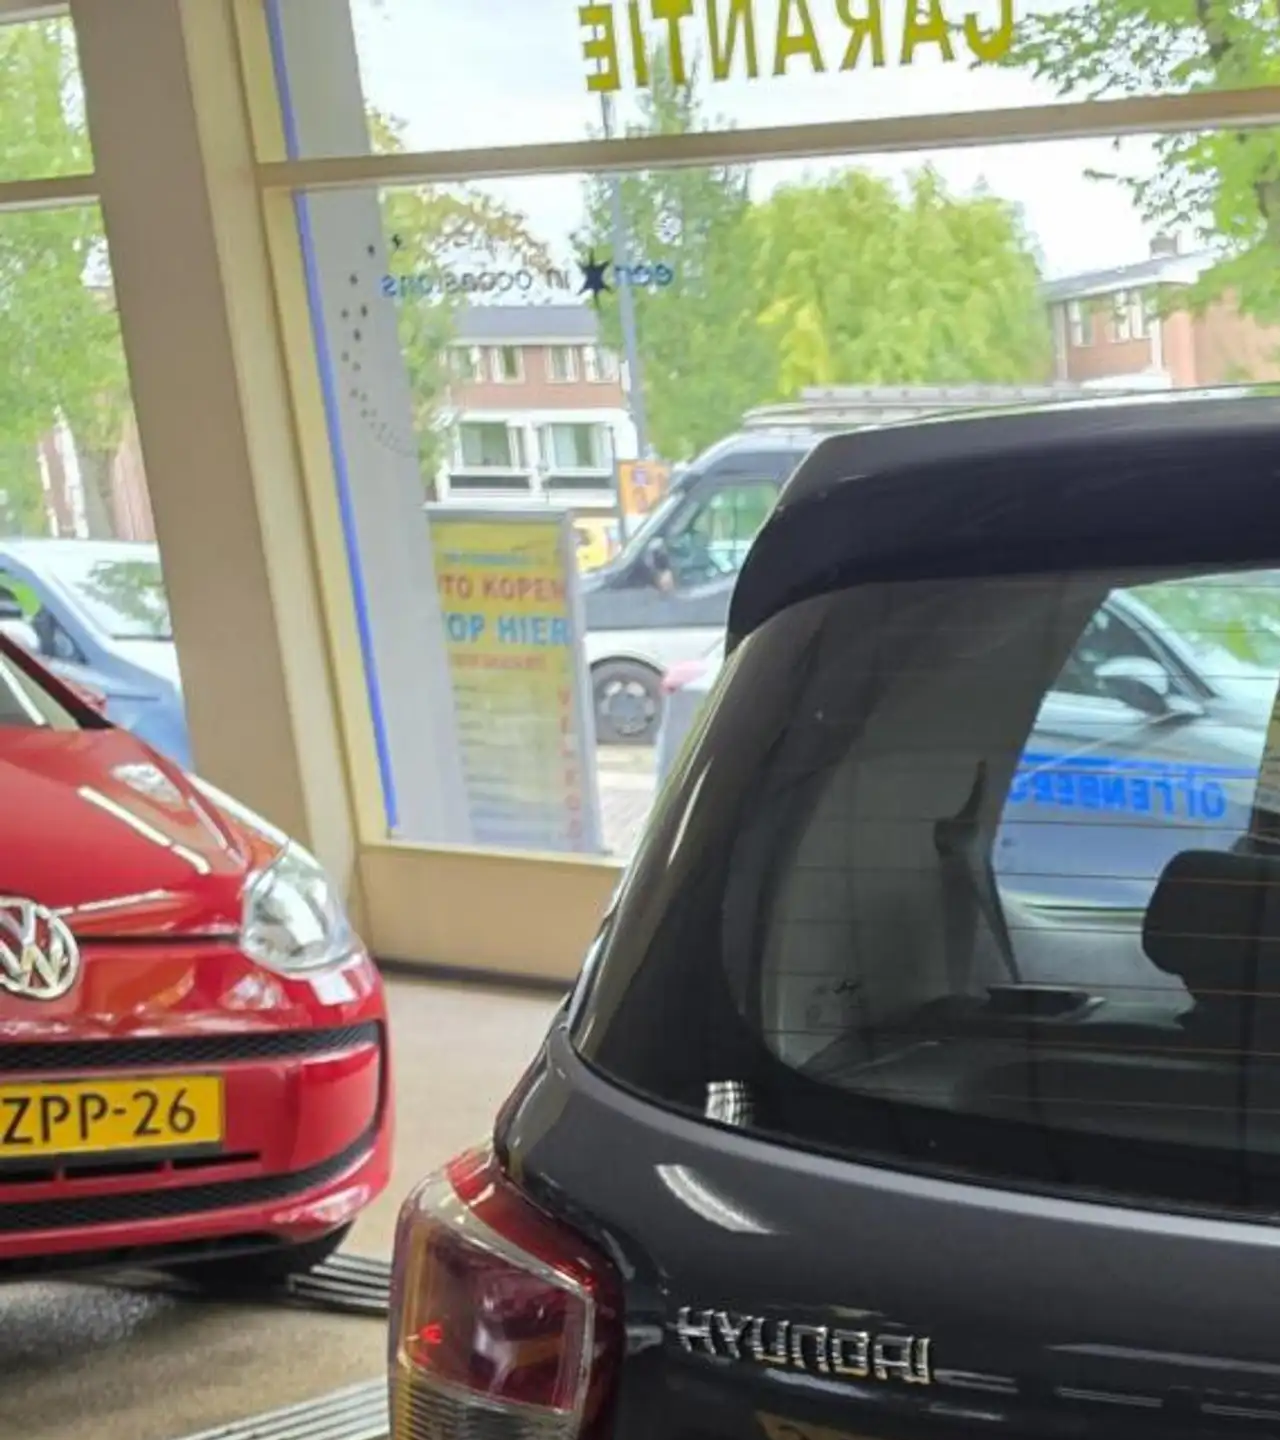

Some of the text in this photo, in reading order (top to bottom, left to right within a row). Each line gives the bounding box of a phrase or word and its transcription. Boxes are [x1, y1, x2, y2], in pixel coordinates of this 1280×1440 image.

[438, 572, 474, 601] TO
[498, 614, 574, 646] HIER
[677, 1305, 931, 1386] HYUNDAI
